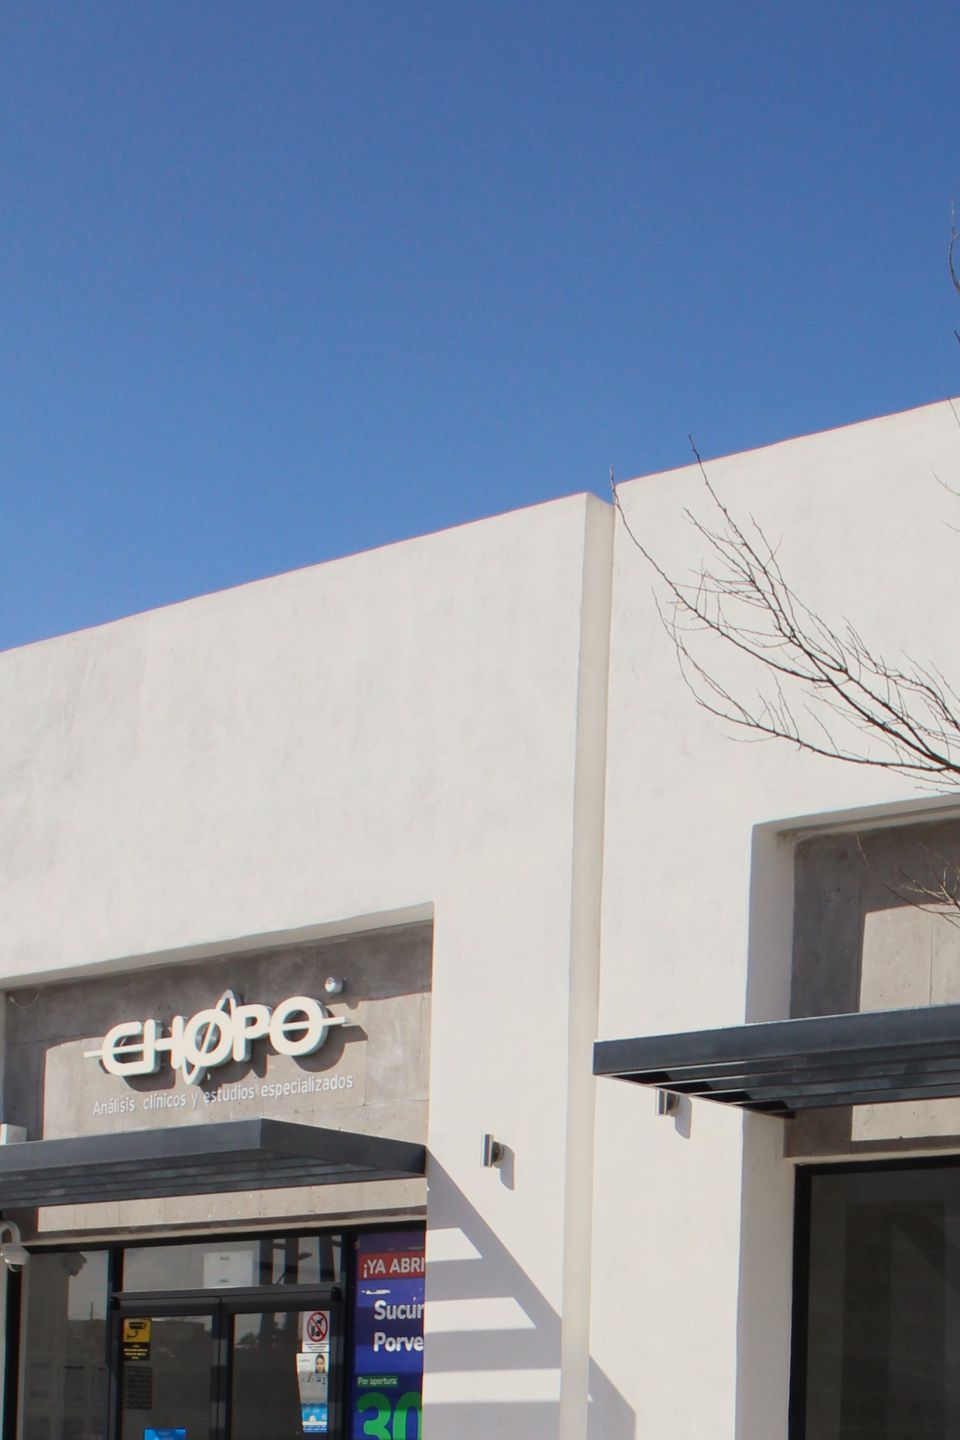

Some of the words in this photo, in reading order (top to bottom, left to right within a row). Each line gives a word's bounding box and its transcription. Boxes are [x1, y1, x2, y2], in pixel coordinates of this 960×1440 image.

[100, 994, 329, 1078] CHOPO
[92, 1096, 136, 1115] Análisis
[143, 1092, 187, 1110] clínicos
[192, 1092, 199, 1108] y
[203, 1084, 255, 1104] estudios
[261, 1074, 353, 1099] especializados
[363, 1258, 386, 1278] ¡YA
[373, 1331, 424, 1352] Porve
